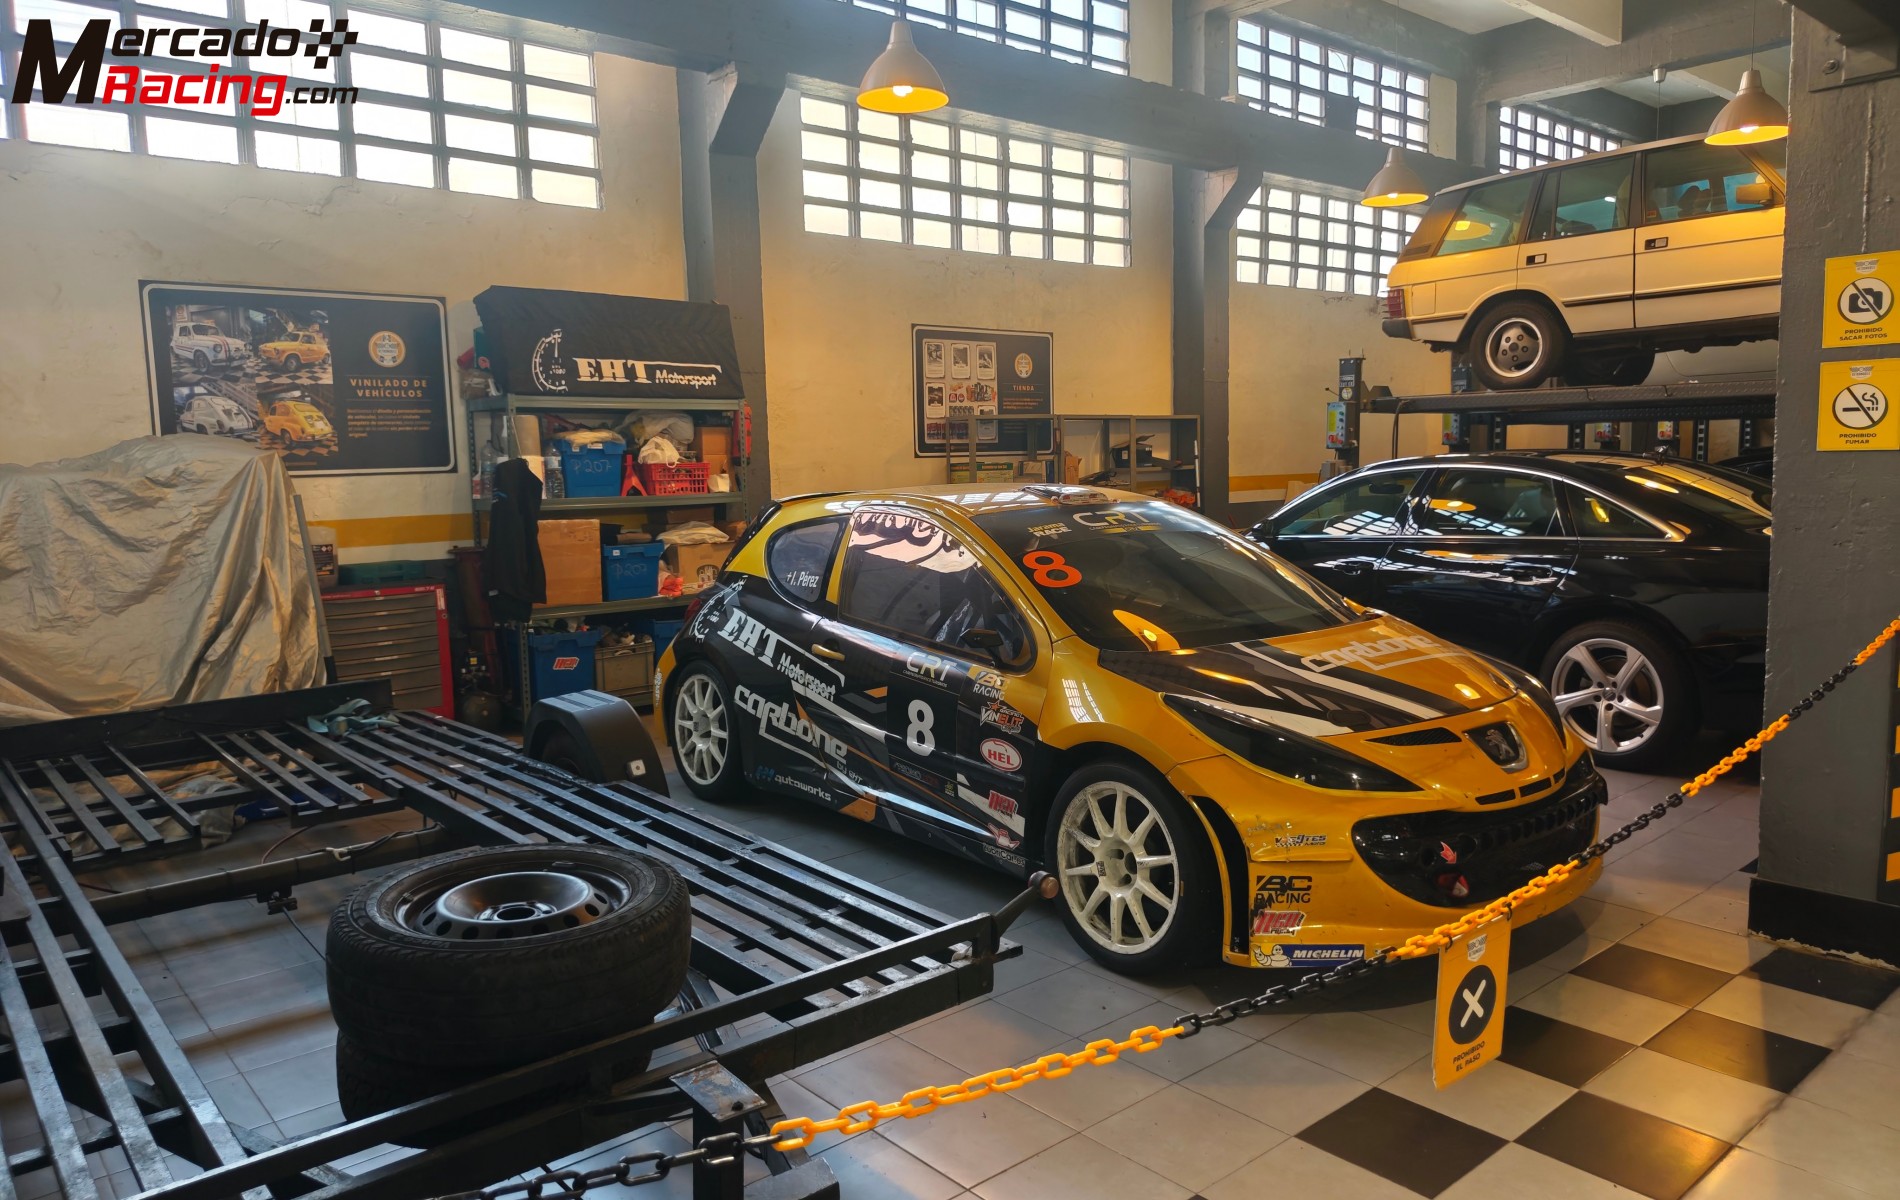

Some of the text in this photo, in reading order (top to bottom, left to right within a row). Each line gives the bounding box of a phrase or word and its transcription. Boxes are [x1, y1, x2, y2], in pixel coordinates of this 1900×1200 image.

[1844, 327, 1883, 335] PROHIBIDO
[1864, 332, 1888, 340] FOTOS
[350, 378, 428, 388] VINILADO DE
[655, 369, 717, 389] Motorsport
[356, 387, 423, 398] VEHÍCULOS
[1012, 384, 1035, 392] TIENDA
[1027, 522, 1066, 533] Jarama
[1073, 510, 1151, 528] CRT
[1033, 526, 1073, 538] RACE
[1022, 550, 1083, 588] 8
[799, 572, 819, 587] Pérez
[906, 651, 957, 682] CRT
[776, 653, 836, 702] Motorsport
[973, 683, 1005, 700] RACING
[907, 699, 935, 757] 8
[987, 749, 1015, 766] HEL
[774, 774, 832, 802] autoworks
[1256, 892, 1311, 904] RACING
[1293, 949, 1364, 959] MICHELIN
[1453, 1041, 1485, 1064] PROHIBIDO
[1456, 1053, 1481, 1072] EL PASO
